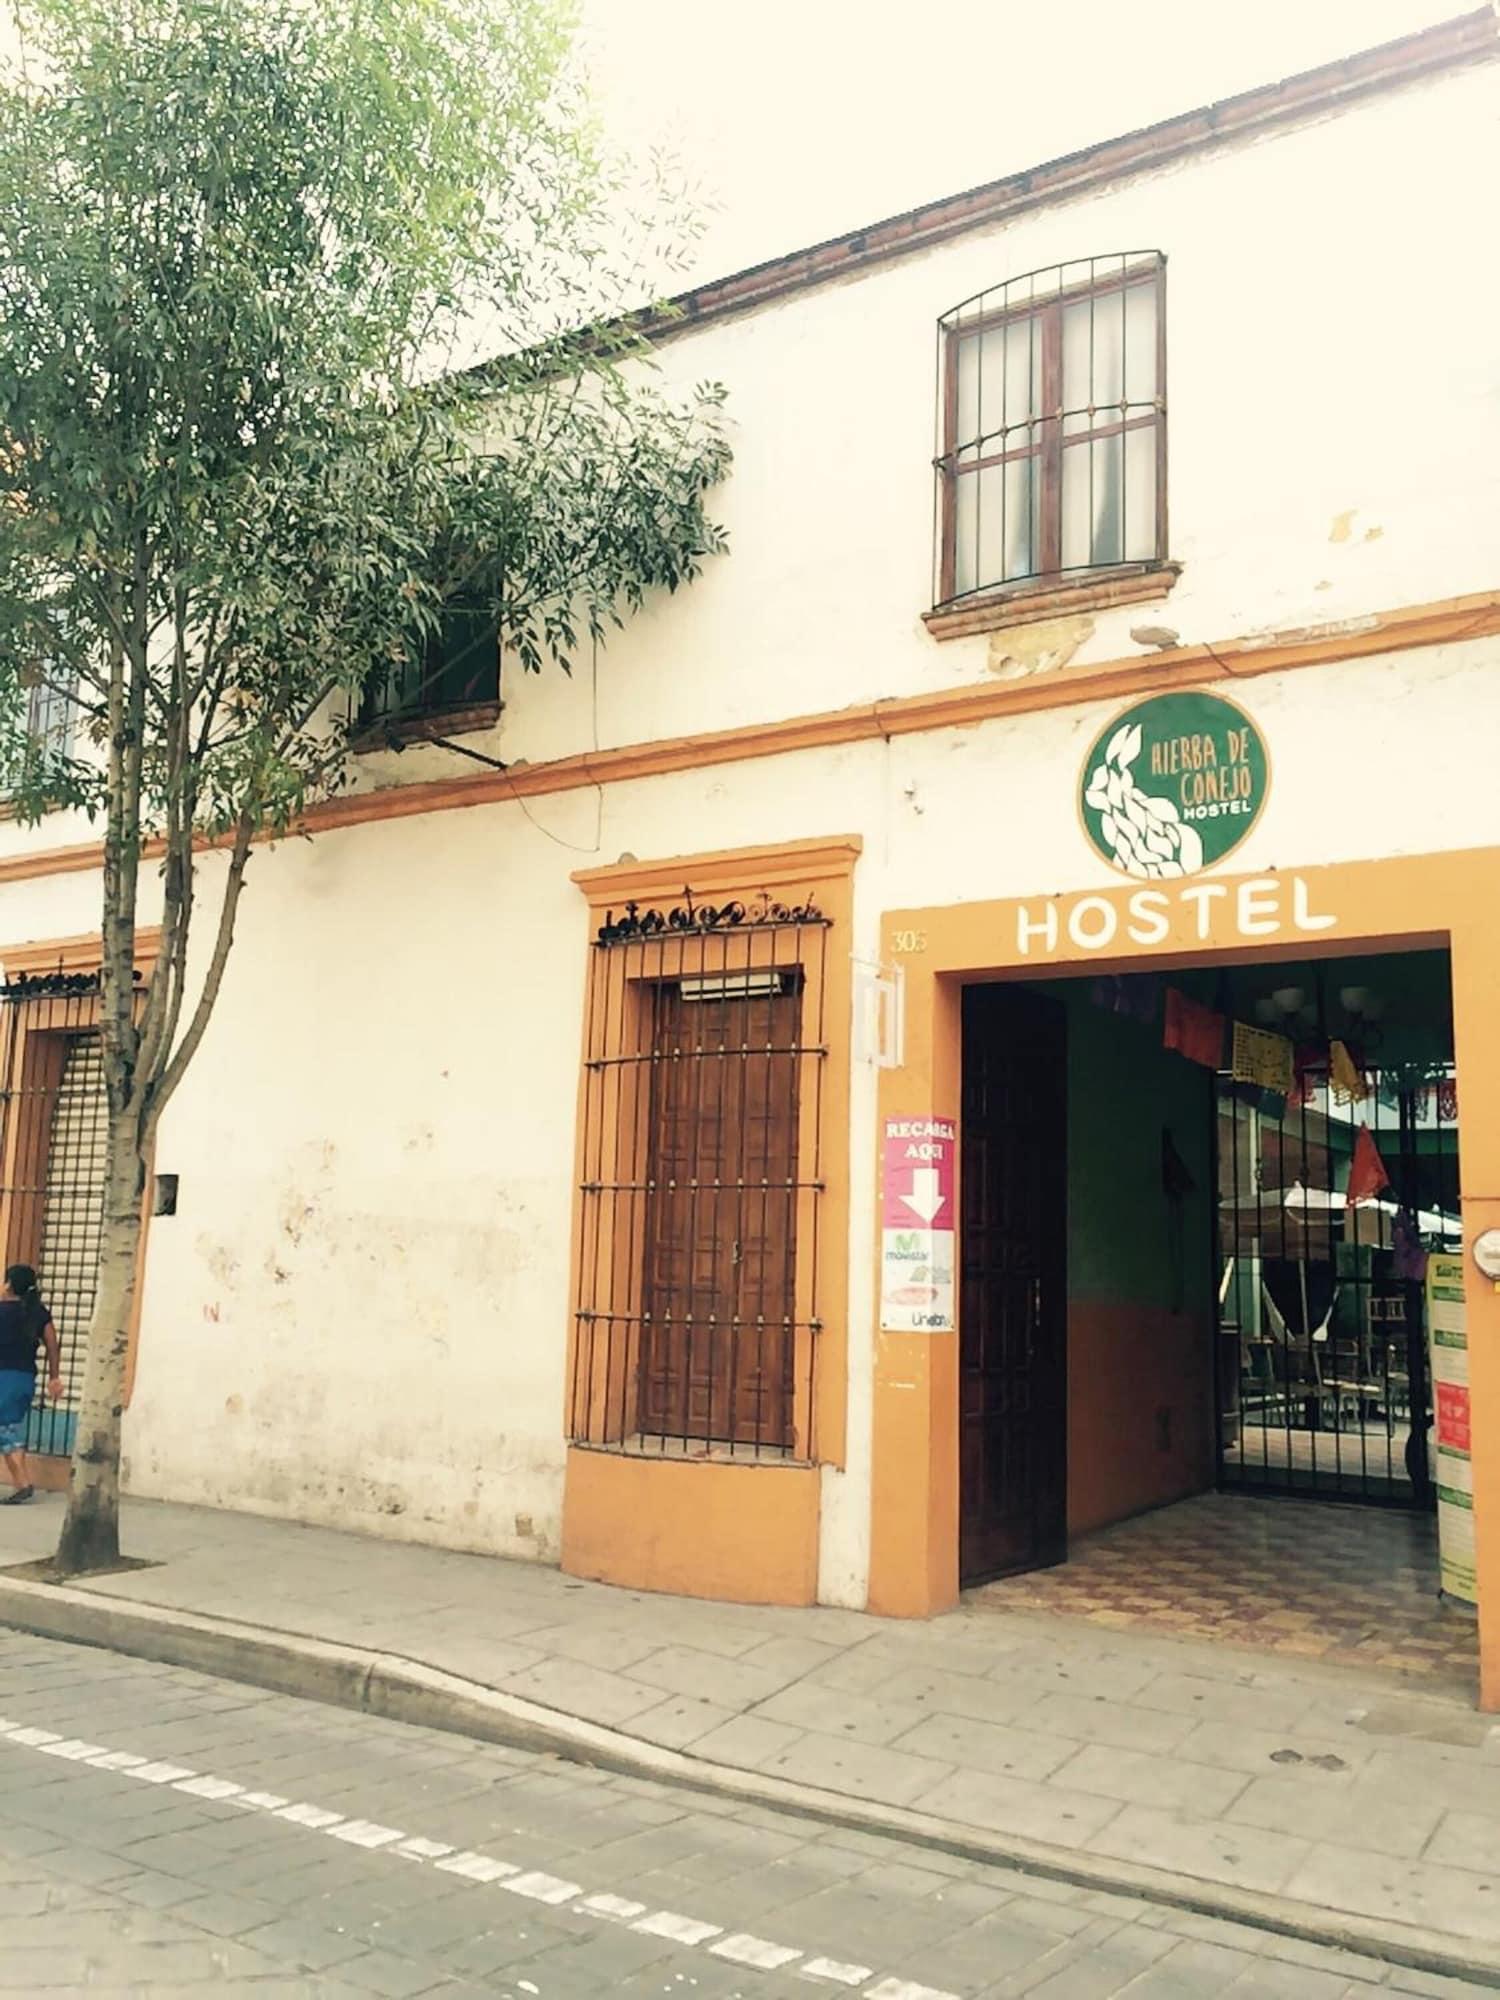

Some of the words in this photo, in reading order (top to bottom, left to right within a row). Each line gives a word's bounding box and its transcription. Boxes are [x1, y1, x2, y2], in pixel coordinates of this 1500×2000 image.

[1151, 733, 1217, 777] HIERBA
[1226, 726, 1249, 766] DE
[1181, 765, 1252, 806] CONEJO
[1183, 799, 1252, 820] HOSTEL
[1016, 876, 1338, 955] HOSTEL
